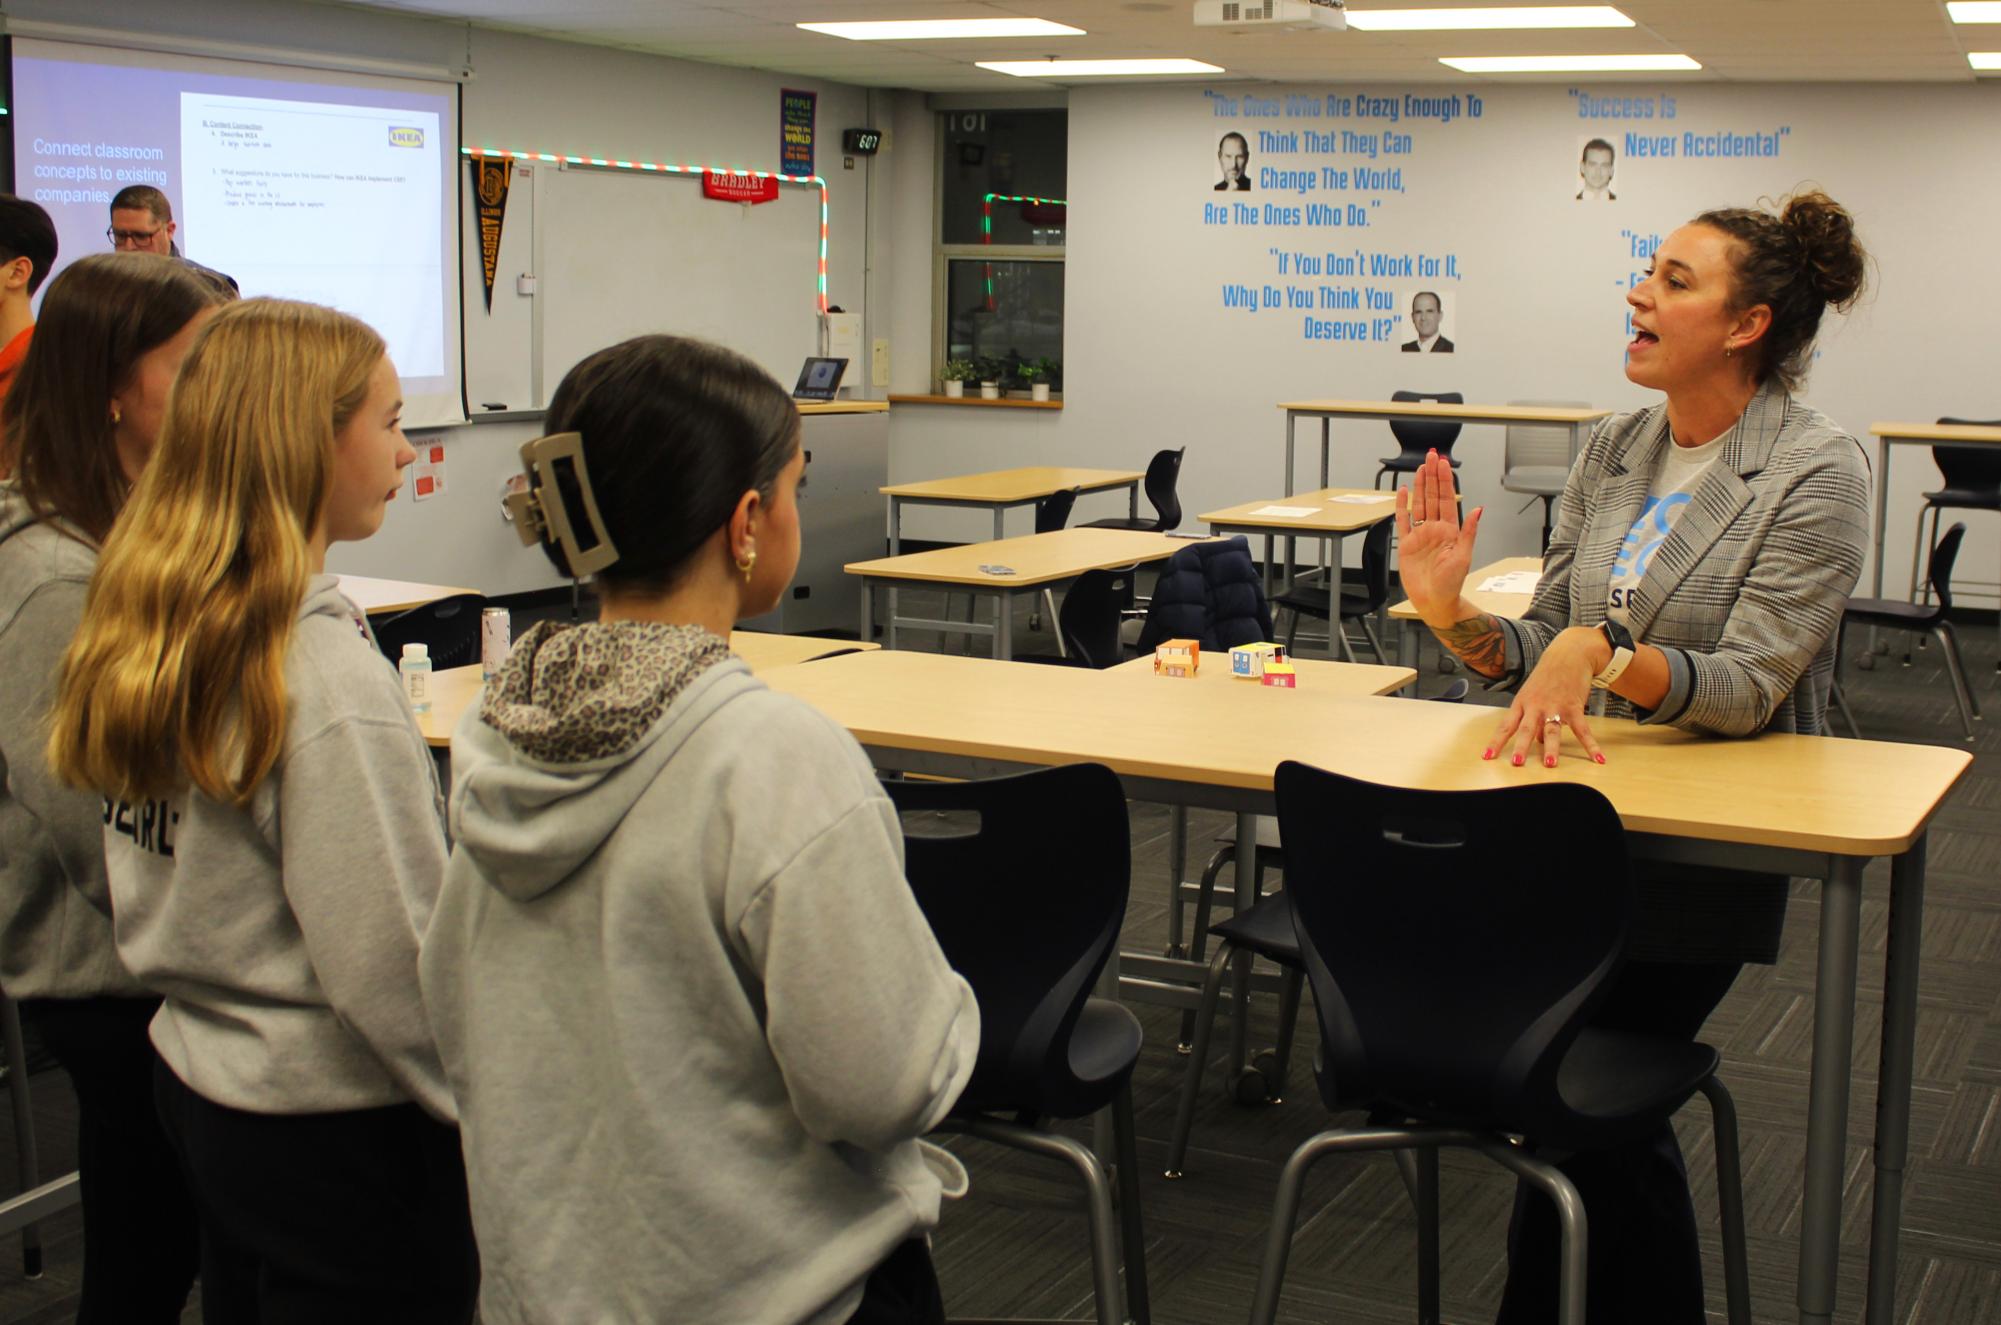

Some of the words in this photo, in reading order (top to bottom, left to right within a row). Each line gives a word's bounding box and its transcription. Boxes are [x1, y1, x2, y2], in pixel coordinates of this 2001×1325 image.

[1203, 90, 1238, 117] "The
[1243, 95, 1280, 118] Ones
[1285, 95, 1321, 118] Who
[1326, 94, 1351, 118] Are
[1355, 95, 1399, 122] Crazy
[1404, 94, 1461, 123] Enough
[1466, 94, 1483, 118] To
[1568, 88, 1654, 120] "Success
[1659, 94, 1677, 120] Is
[33, 138, 92, 157] Connect
[95, 142, 163, 160] classroom
[392, 132, 421, 144] IKEA
[785, 133, 811, 145] WORLD
[1258, 130, 1298, 154] Think
[1303, 131, 1336, 154] That
[1341, 131, 1378, 158] They
[1382, 131, 1412, 154] Can
[1624, 131, 1678, 157] Never
[1682, 126, 1791, 157] Accidental"
[34, 164, 97, 182] concepts
[100, 166, 112, 181] to
[116, 166, 167, 186] existing
[711, 173, 765, 189] BRADLEY
[1260, 167, 1316, 194] Change
[1321, 167, 1348, 190] The
[1353, 168, 1405, 193] World,
[1204, 203, 1228, 225] Are
[1233, 203, 1259, 225] The
[1264, 203, 1301, 226] Ones
[1305, 204, 1342, 226] Who
[1347, 200, 1381, 227] Do."
[1269, 248, 1289, 275] "If
[1294, 253, 1321, 276] You
[1326, 250, 1365, 276] Don't
[1370, 253, 1413, 277] Work
[1418, 254, 1441, 277] For
[1445, 255, 1461, 281] It,
[1222, 285, 1258, 312] Why
[1263, 285, 1282, 308] Do
[1286, 286, 1314, 309] You
[1318, 286, 1360, 310] Think
[1365, 287, 1394, 310] You
[1303, 316, 1368, 341] Deserve
[1372, 315, 1402, 342] It?"
